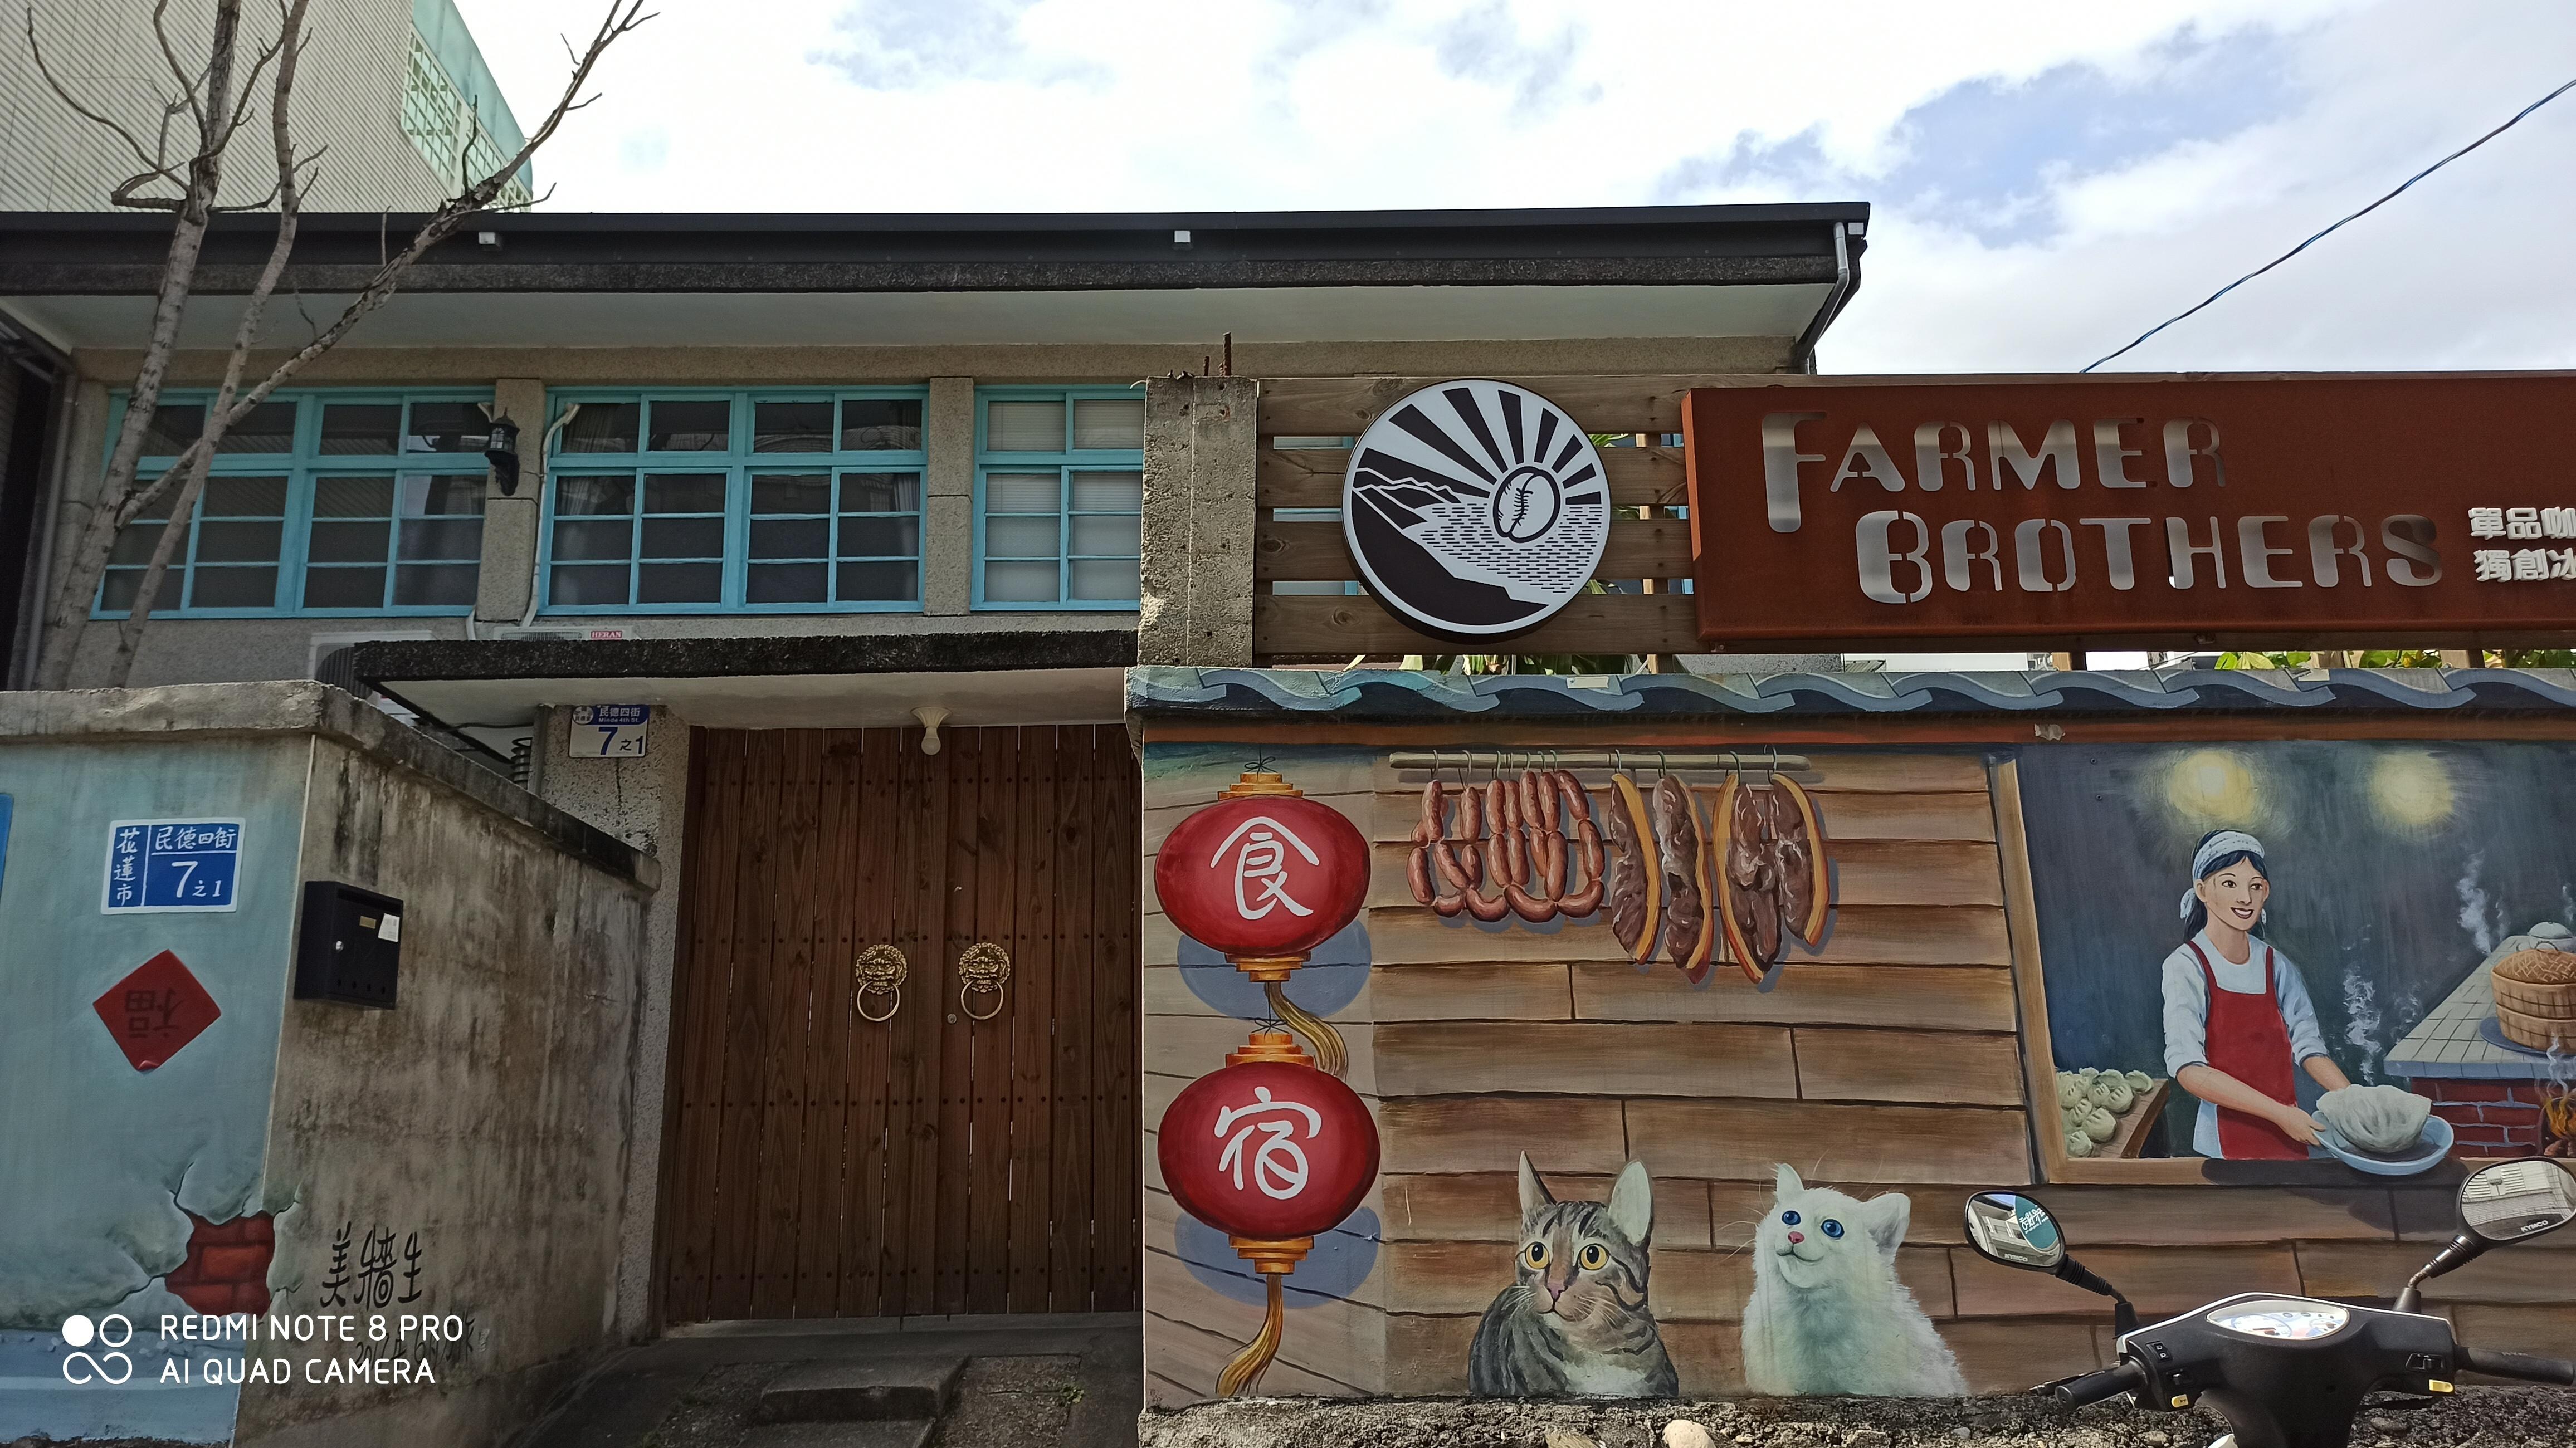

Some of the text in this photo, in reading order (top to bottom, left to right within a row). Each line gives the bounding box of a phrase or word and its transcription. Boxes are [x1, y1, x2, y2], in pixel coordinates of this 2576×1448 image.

[1762, 412, 2225, 533] FARMER
[2468, 506, 2576, 540] 單品咖
[1855, 510, 2442, 604] BROTHERS
[2473, 547, 2576, 583] 獨創冰
[599, 706, 641, 717] 民德四街
[155, 826, 237, 850] 民德四街
[113, 827, 140, 906] 花蓮市
[1210, 816, 1320, 920] 食
[1214, 1086, 1322, 1200] 宿
[2520, 1220, 2549, 1232] KYMCO
[2004, 1253, 2028, 1262] KYMCO
